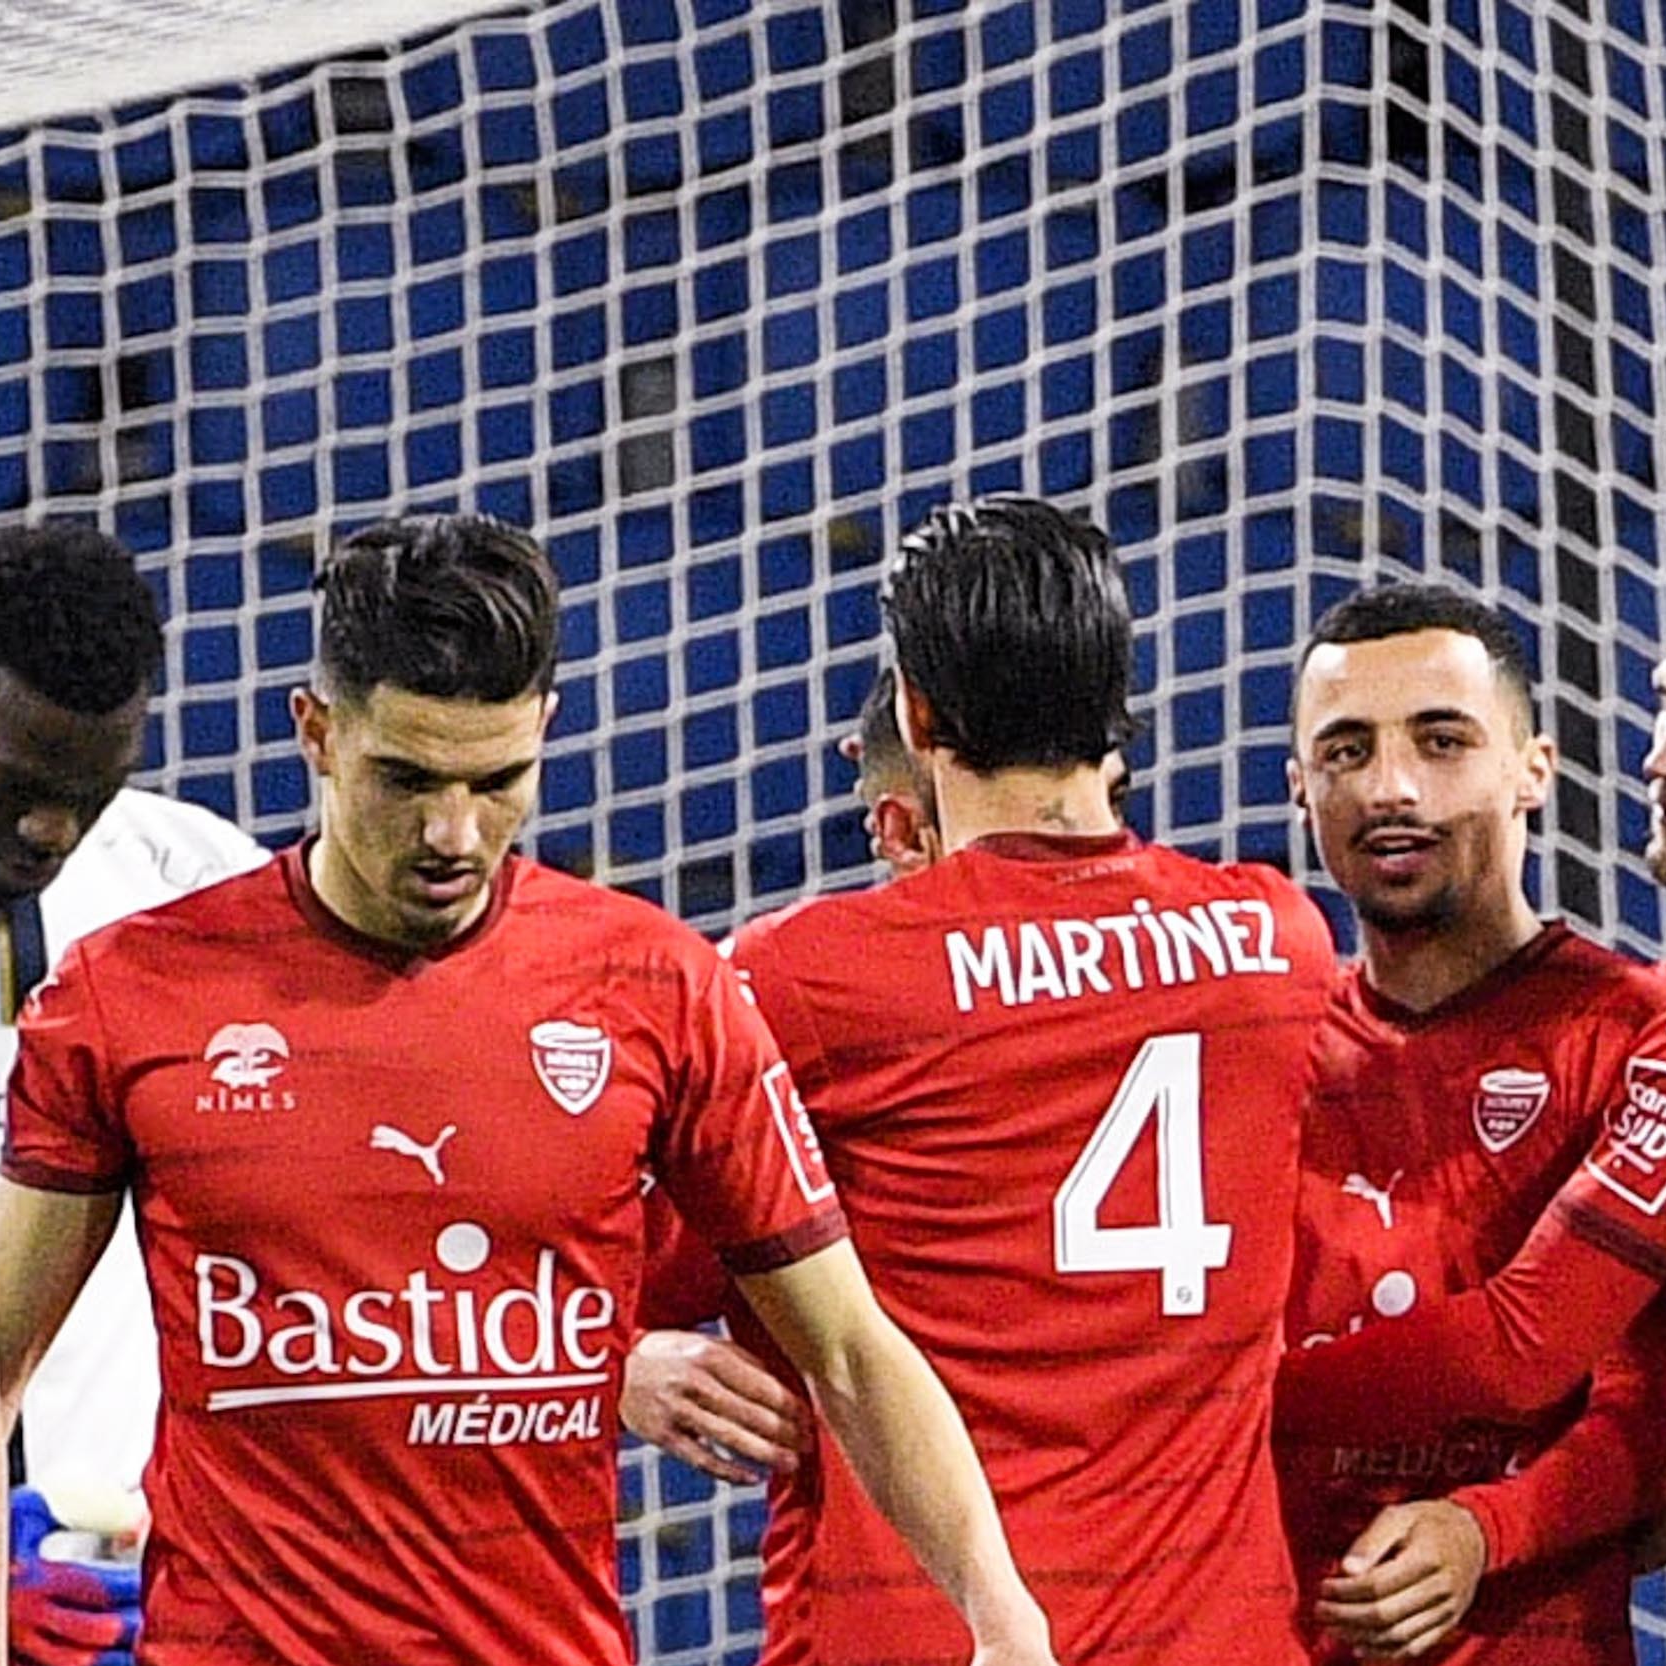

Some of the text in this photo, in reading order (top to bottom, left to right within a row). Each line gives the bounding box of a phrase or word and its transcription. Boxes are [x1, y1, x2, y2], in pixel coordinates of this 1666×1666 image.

[1053, 1033, 1231, 1317] 4
[194, 1221, 615, 1376] Bastide
[406, 1394, 601, 1446] MÉDICAL
